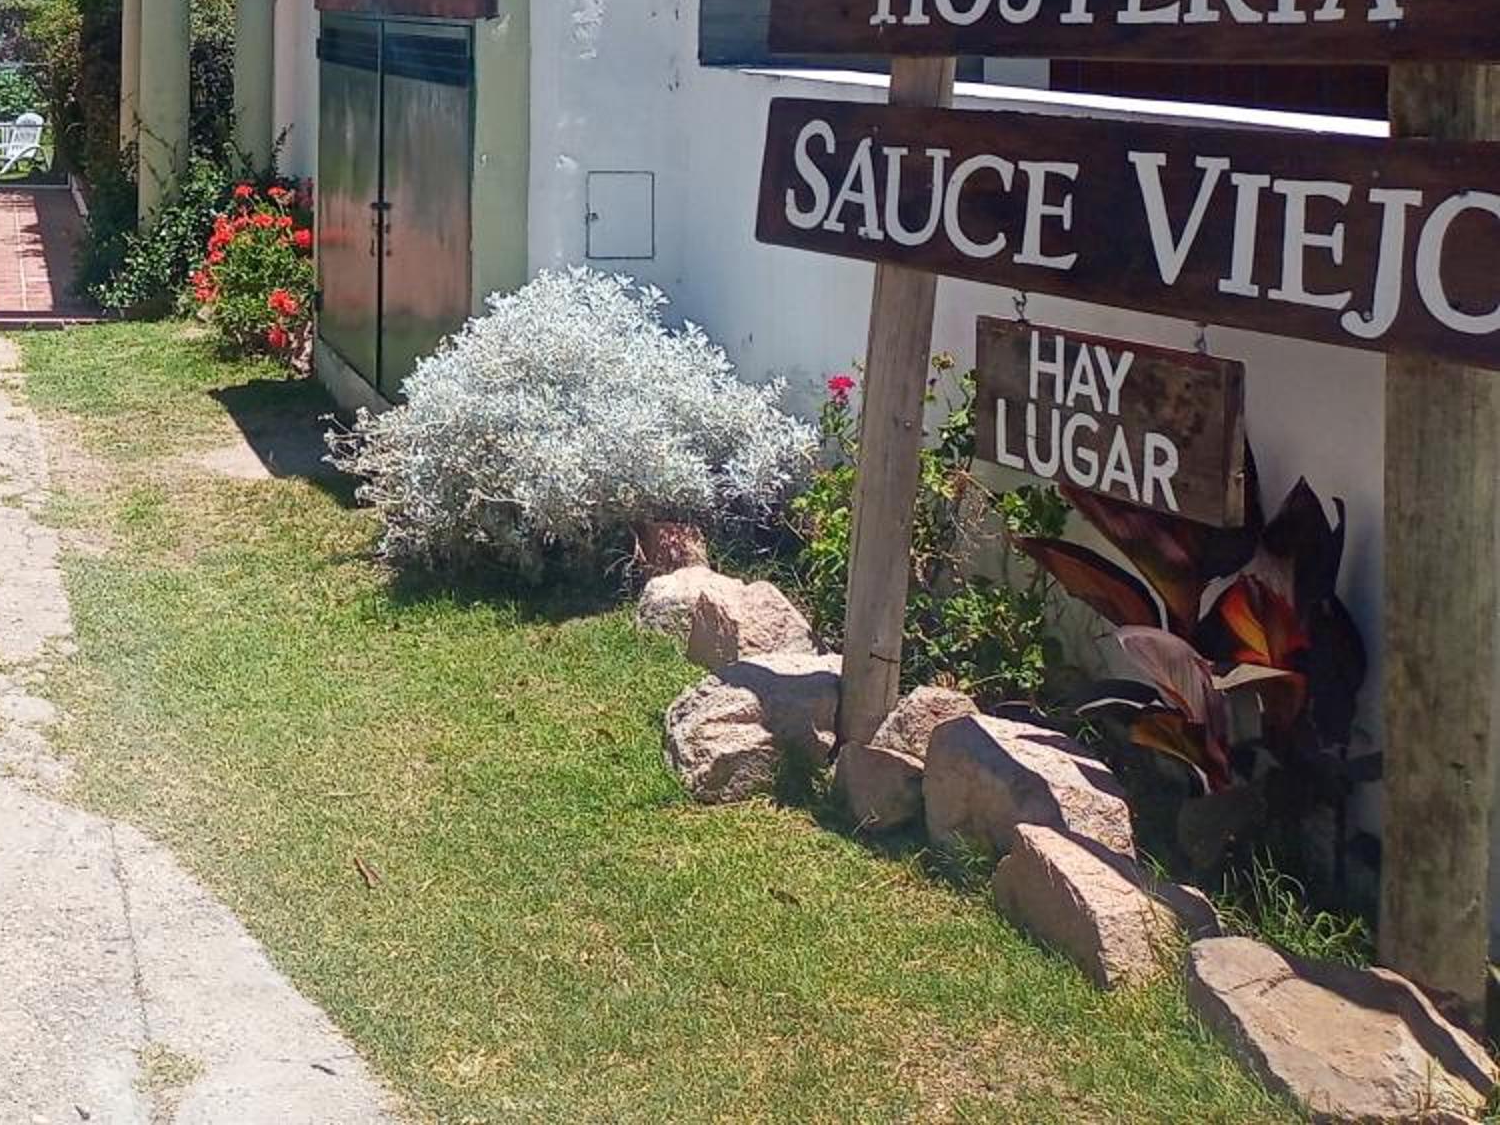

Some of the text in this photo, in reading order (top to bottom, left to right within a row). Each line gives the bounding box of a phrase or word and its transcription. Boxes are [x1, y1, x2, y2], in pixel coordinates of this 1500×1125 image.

[785, 119, 1500, 339] SAUCE VIEJO
[1028, 329, 1134, 416] HAY
[996, 398, 1180, 512] LUGAR
